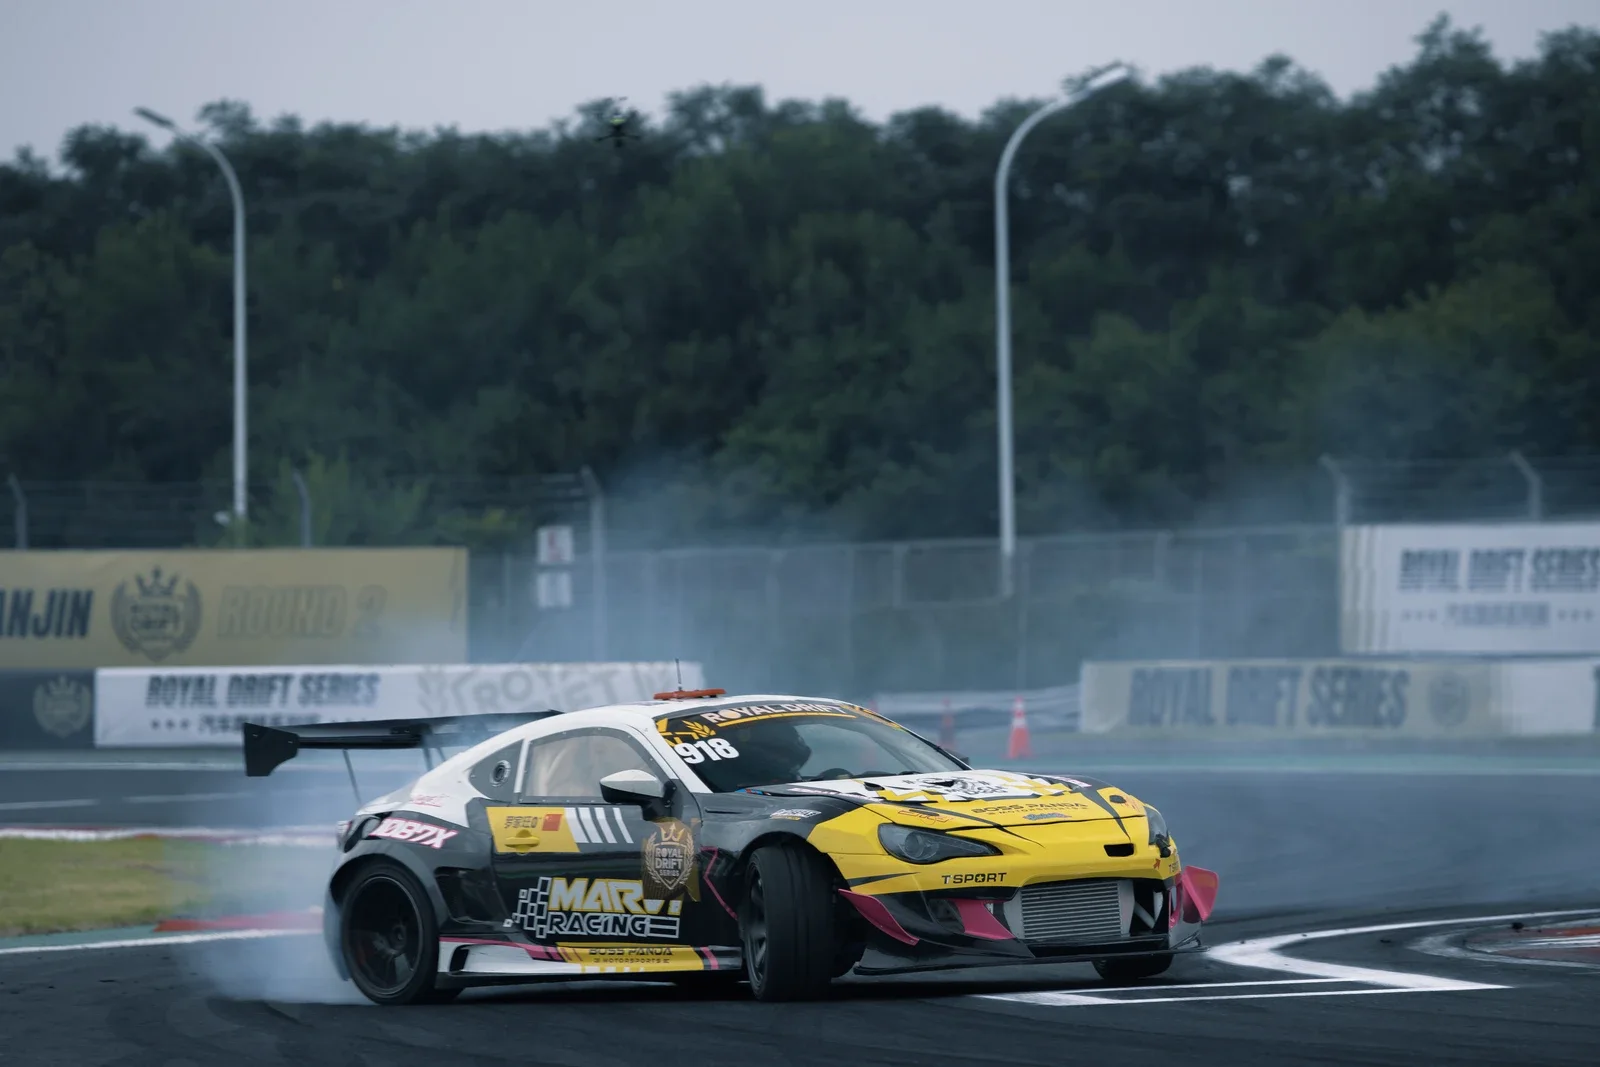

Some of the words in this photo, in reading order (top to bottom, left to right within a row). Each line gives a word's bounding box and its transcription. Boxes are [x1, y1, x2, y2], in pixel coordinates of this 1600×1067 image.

[217, 585, 348, 639] ROUND
[352, 584, 388, 640] 2
[146, 674, 217, 707] ROYAL
[226, 674, 294, 707] DRIFT
[298, 673, 381, 707] SERIES
[701, 704, 786, 723] ROYAL
[785, 703, 847, 714] DRIFT
[673, 738, 740, 764] 918
[972, 804, 1024, 813] BOSS
[1026, 802, 1088, 810] PANDA
[655, 847, 683, 857] ROYAL
[655, 857, 683, 869] DRIFT
[941, 872, 1007, 884] TSPORT
[548, 912, 648, 937] RACING
[589, 947, 624, 955] BOSS
[628, 946, 673, 955] PANDA
